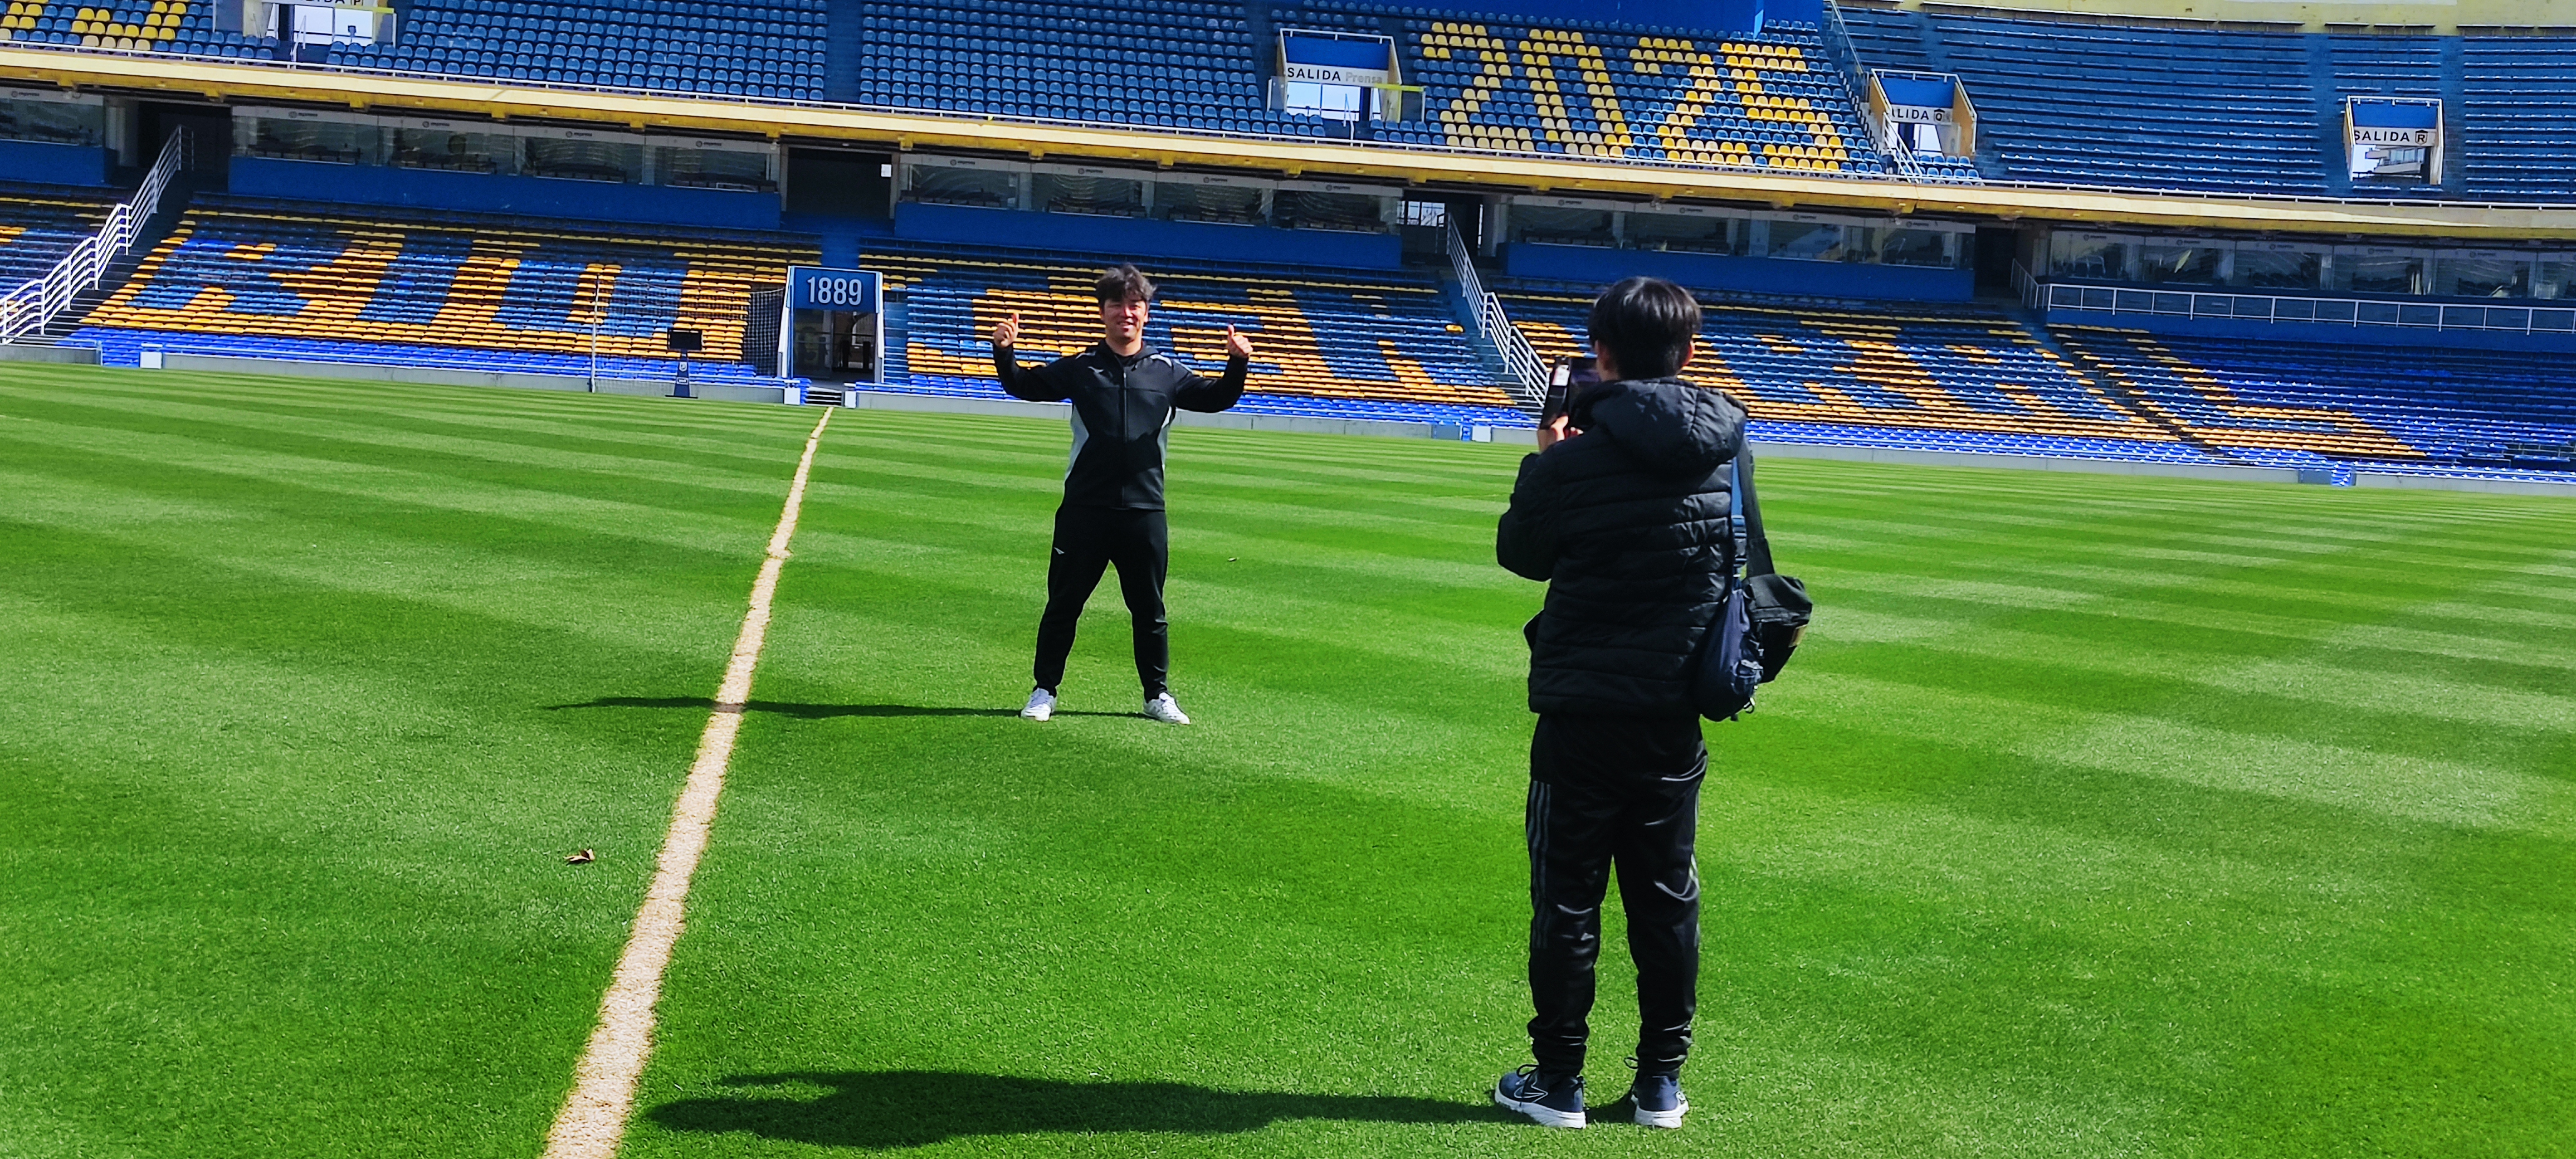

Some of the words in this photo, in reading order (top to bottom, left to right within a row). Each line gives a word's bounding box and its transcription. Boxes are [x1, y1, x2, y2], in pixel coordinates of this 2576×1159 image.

[1287, 67, 1341, 81] SALIDA
[1420, 21, 1848, 173] 2025
[1891, 108, 1929, 120] LIDA
[2354, 130, 2410, 142] SALIDA
[807, 276, 862, 305] 1889
